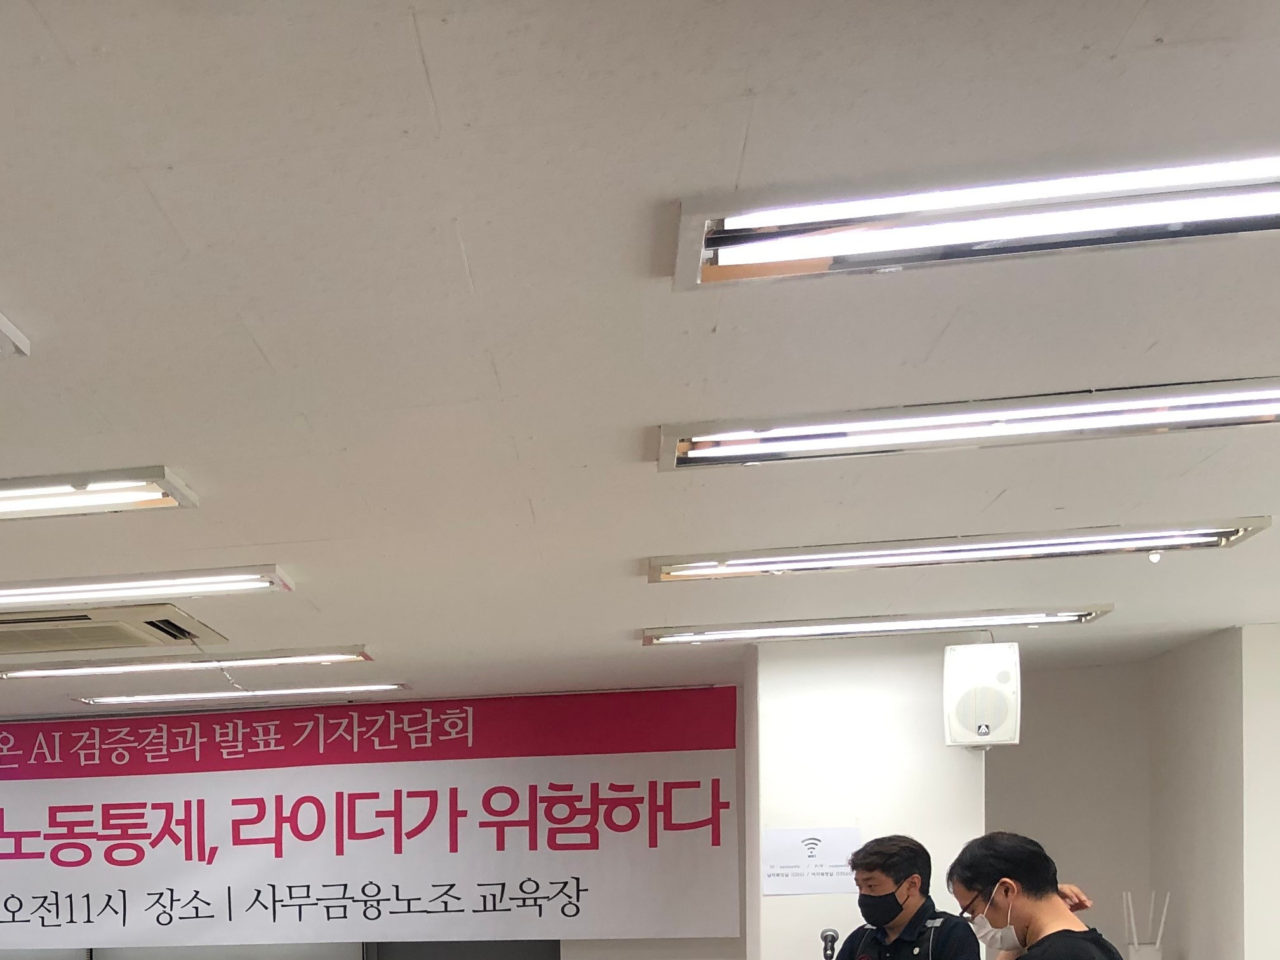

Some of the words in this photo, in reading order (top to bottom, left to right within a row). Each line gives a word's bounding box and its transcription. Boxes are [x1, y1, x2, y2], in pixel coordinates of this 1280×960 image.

[27, 732, 63, 766] AI
[70, 722, 207, 768] 검증결과
[213, 718, 285, 760] 발표
[292, 706, 475, 754] 기자간담회
[231, 786, 467, 859] 라이더가
[478, 777, 730, 853] 위험하다
[144, 886, 215, 926] 장소
[244, 879, 466, 924] 사무금융노조
[472, 876, 589, 919] 교육장
